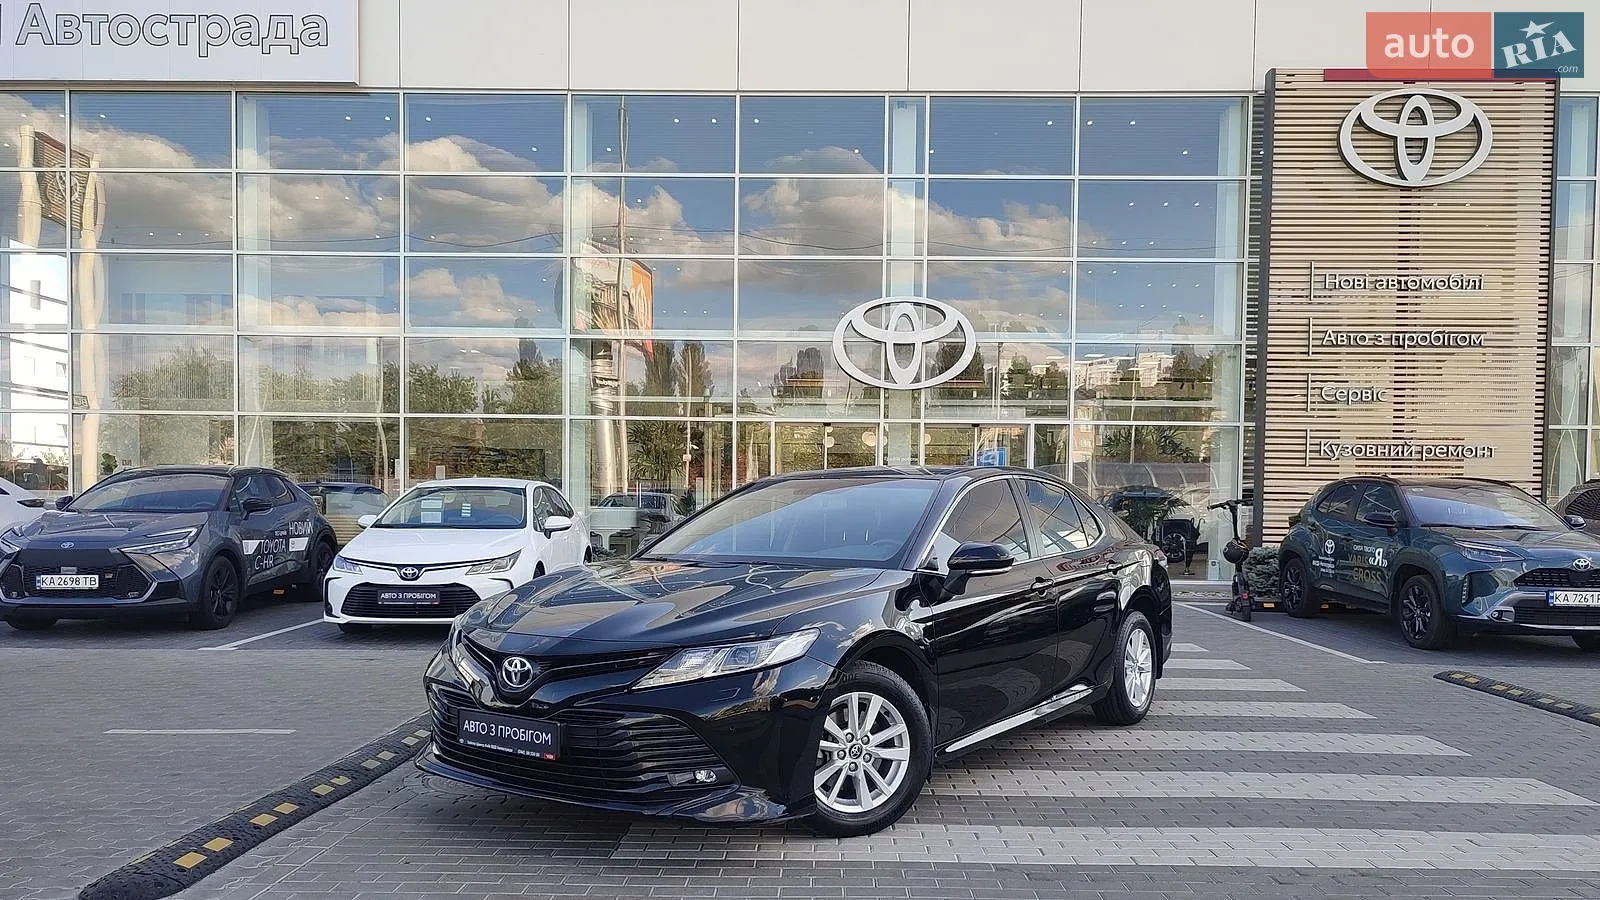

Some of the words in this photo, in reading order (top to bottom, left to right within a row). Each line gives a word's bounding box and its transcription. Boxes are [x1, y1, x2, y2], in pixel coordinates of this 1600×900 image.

[15, 2, 329, 58] Автострада
[1325, 273, 1369, 290] Нові
[1375, 273, 1485, 291] автомобілі
[1322, 329, 1370, 346] Авто
[1374, 334, 1386, 346] з
[1391, 330, 1485, 349] пробігом
[1321, 386, 1388, 405] Сервіс
[1319, 441, 1416, 458] Кузовний
[1422, 446, 1498, 461] ремонт
[260, 539, 287, 553] TOYOTA
[254, 554, 274, 570] C-HR
[57, 576, 81, 586] 2698
[1352, 567, 1382, 582] CROSS
[1572, 593, 1595, 603] 7261
[463, 720, 488, 735] АВТО
[498, 725, 551, 745] ПРОБІГОМ
